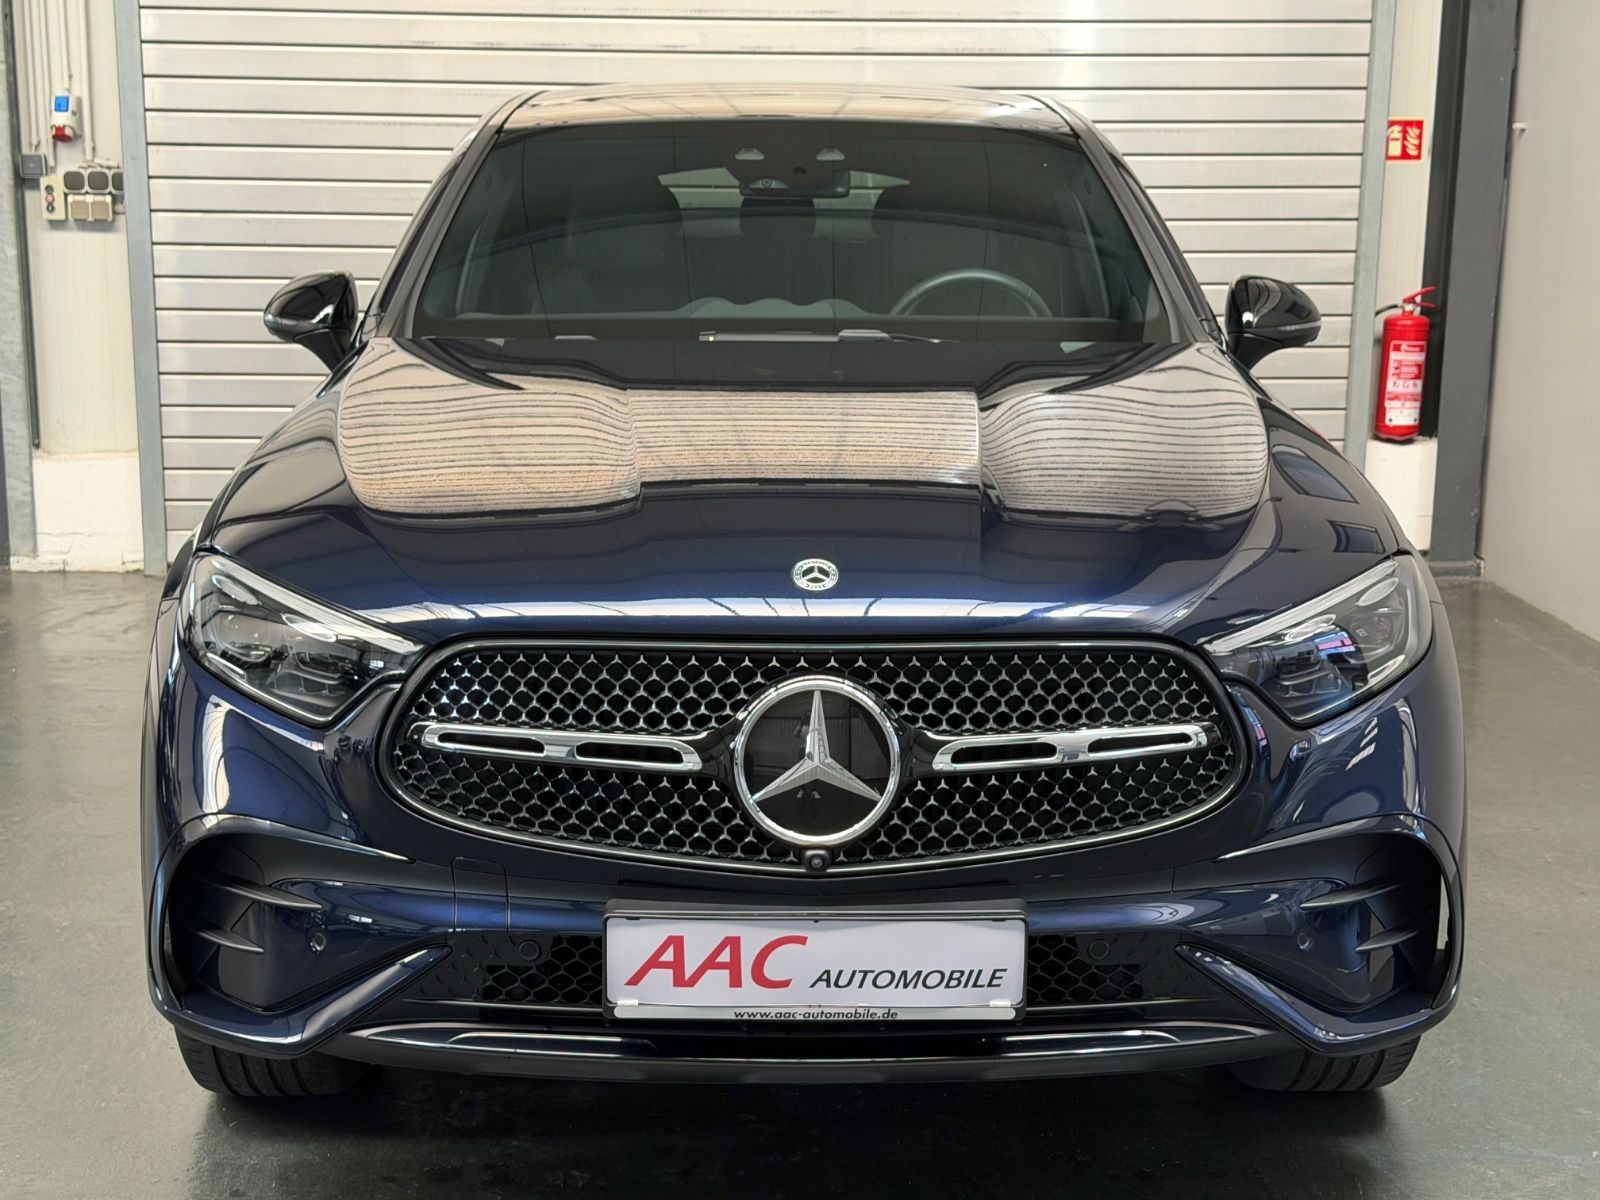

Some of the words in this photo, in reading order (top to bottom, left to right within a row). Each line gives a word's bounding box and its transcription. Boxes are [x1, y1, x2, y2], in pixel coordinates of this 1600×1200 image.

[624, 935, 808, 988] AAC
[810, 968, 1007, 989] AUTOMOBILE
[734, 1009, 898, 1020] www.aac-automobile.de
